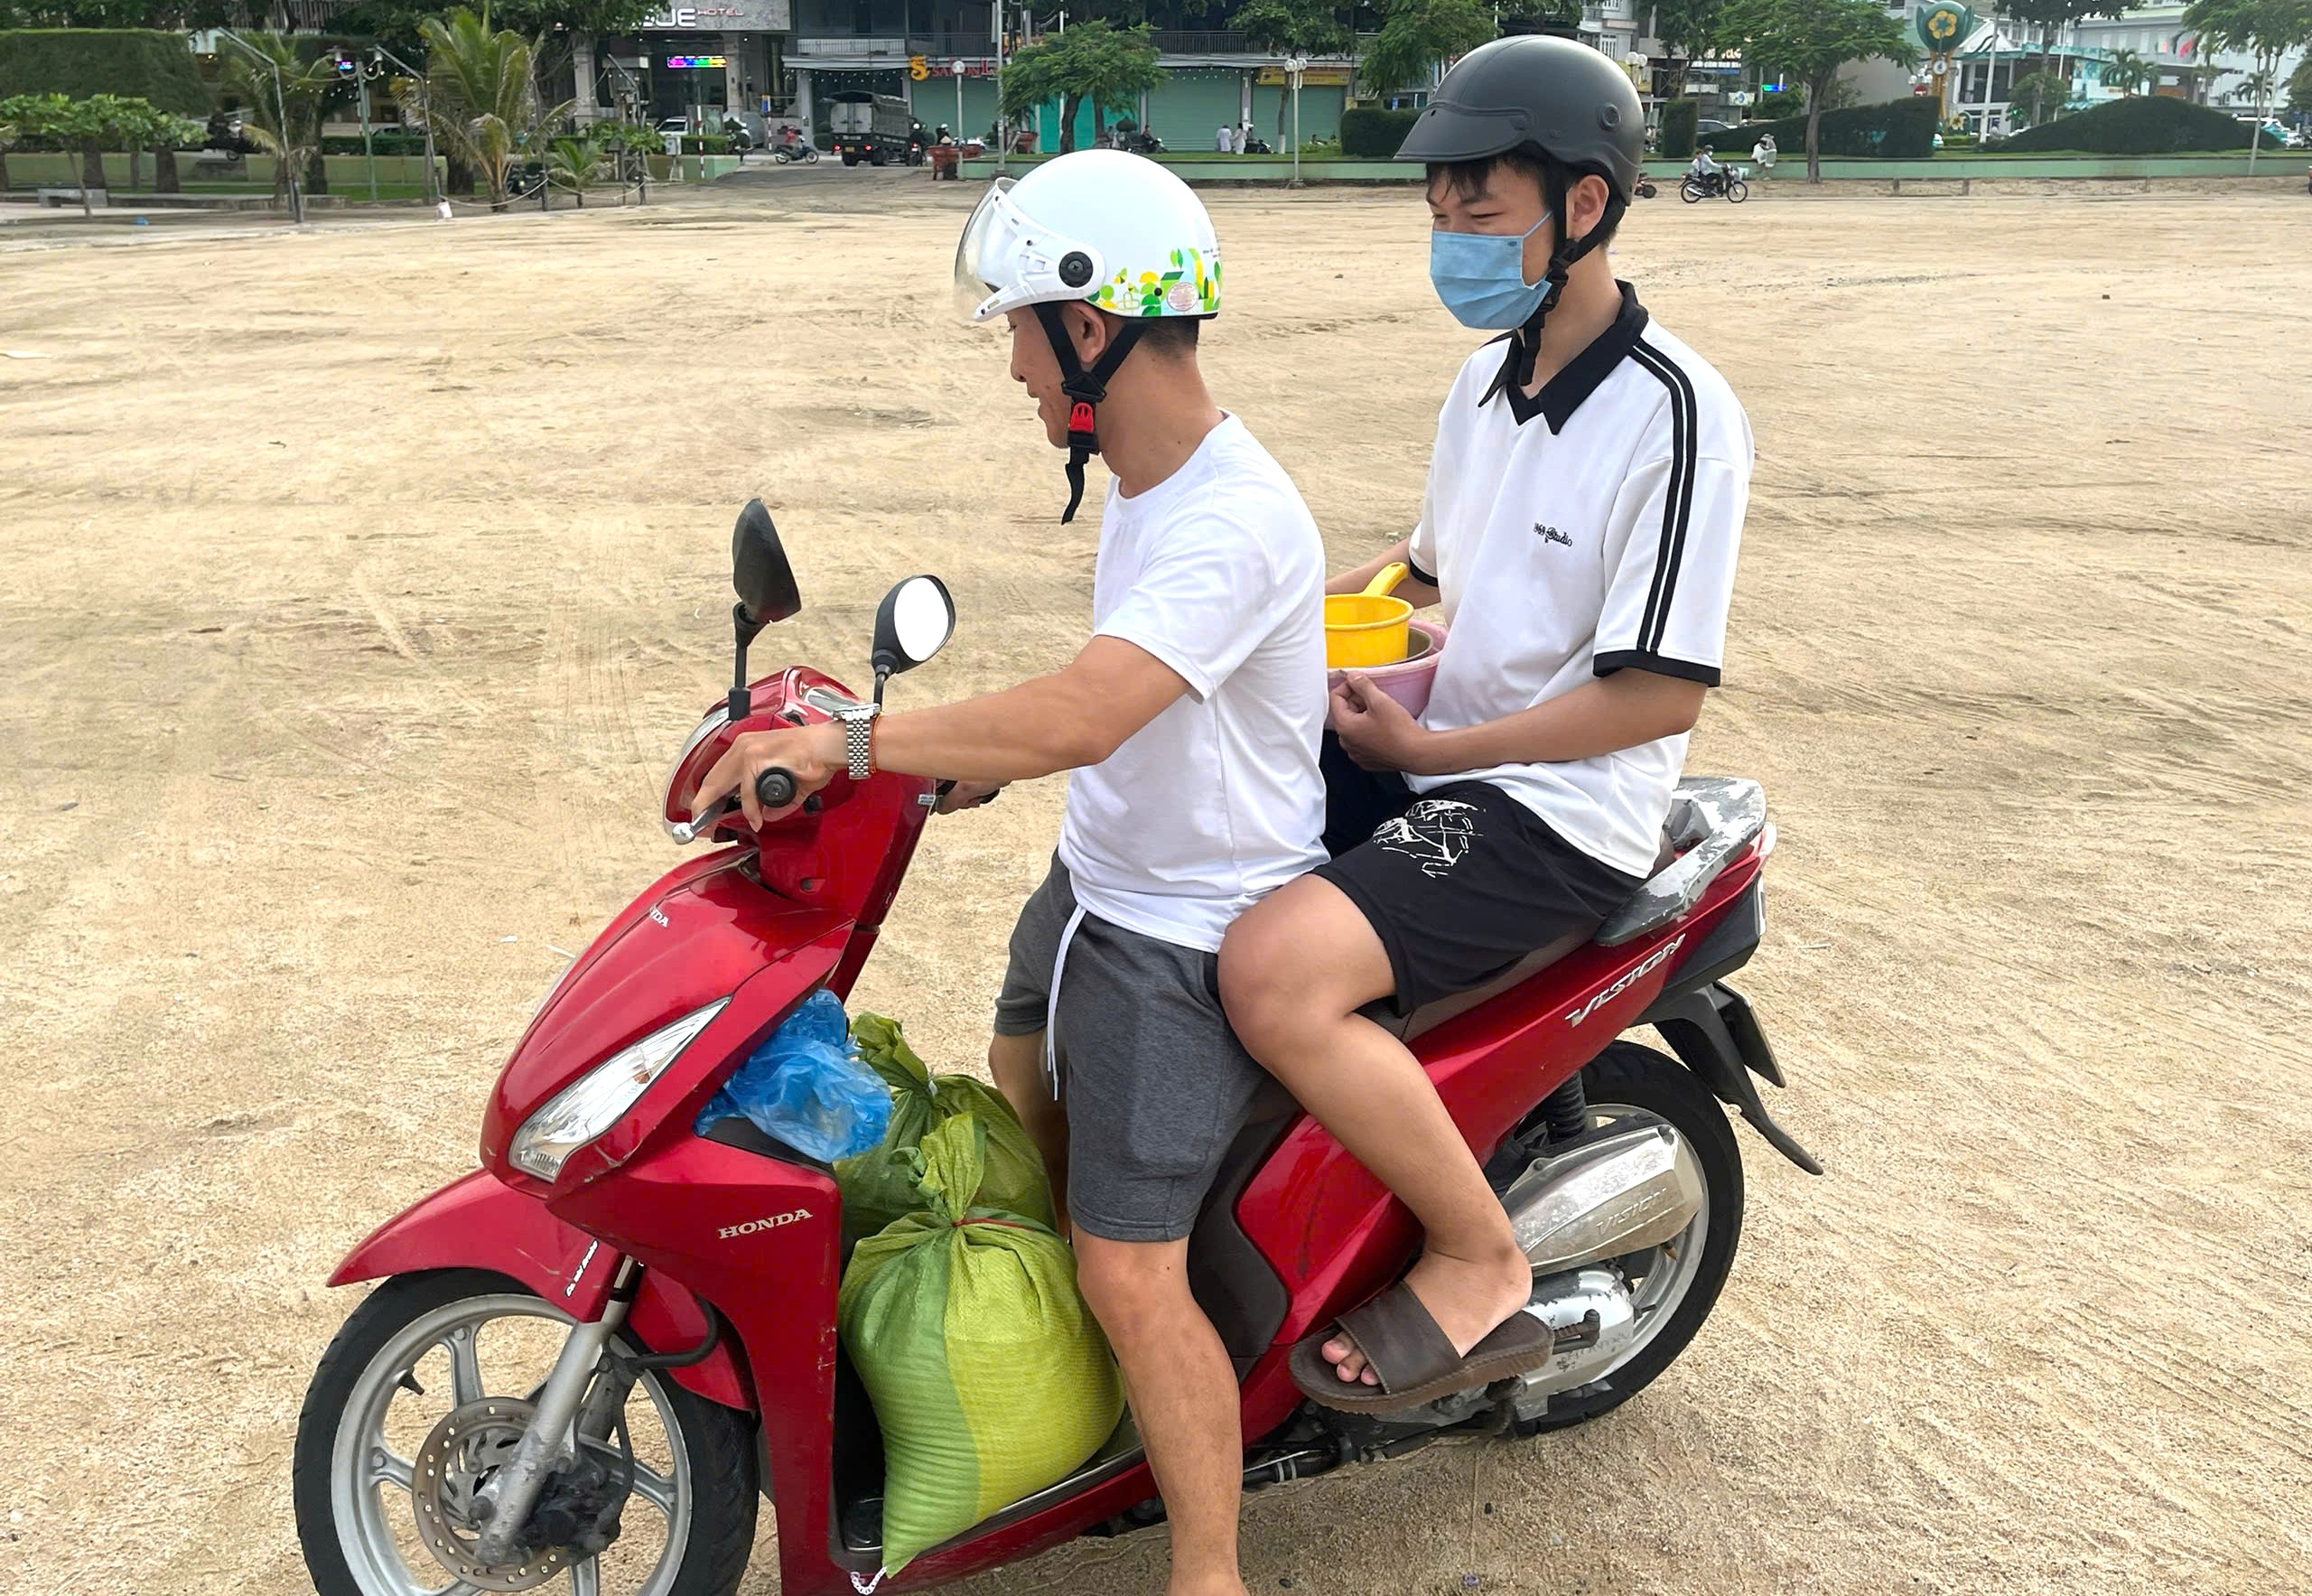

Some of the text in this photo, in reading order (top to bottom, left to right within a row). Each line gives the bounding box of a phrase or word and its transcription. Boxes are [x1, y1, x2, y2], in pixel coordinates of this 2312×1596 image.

[697, 7, 744, 16] HOTEL
[1564, 932, 1686, 1028] VISION
[718, 1209, 814, 1239] HONDA
